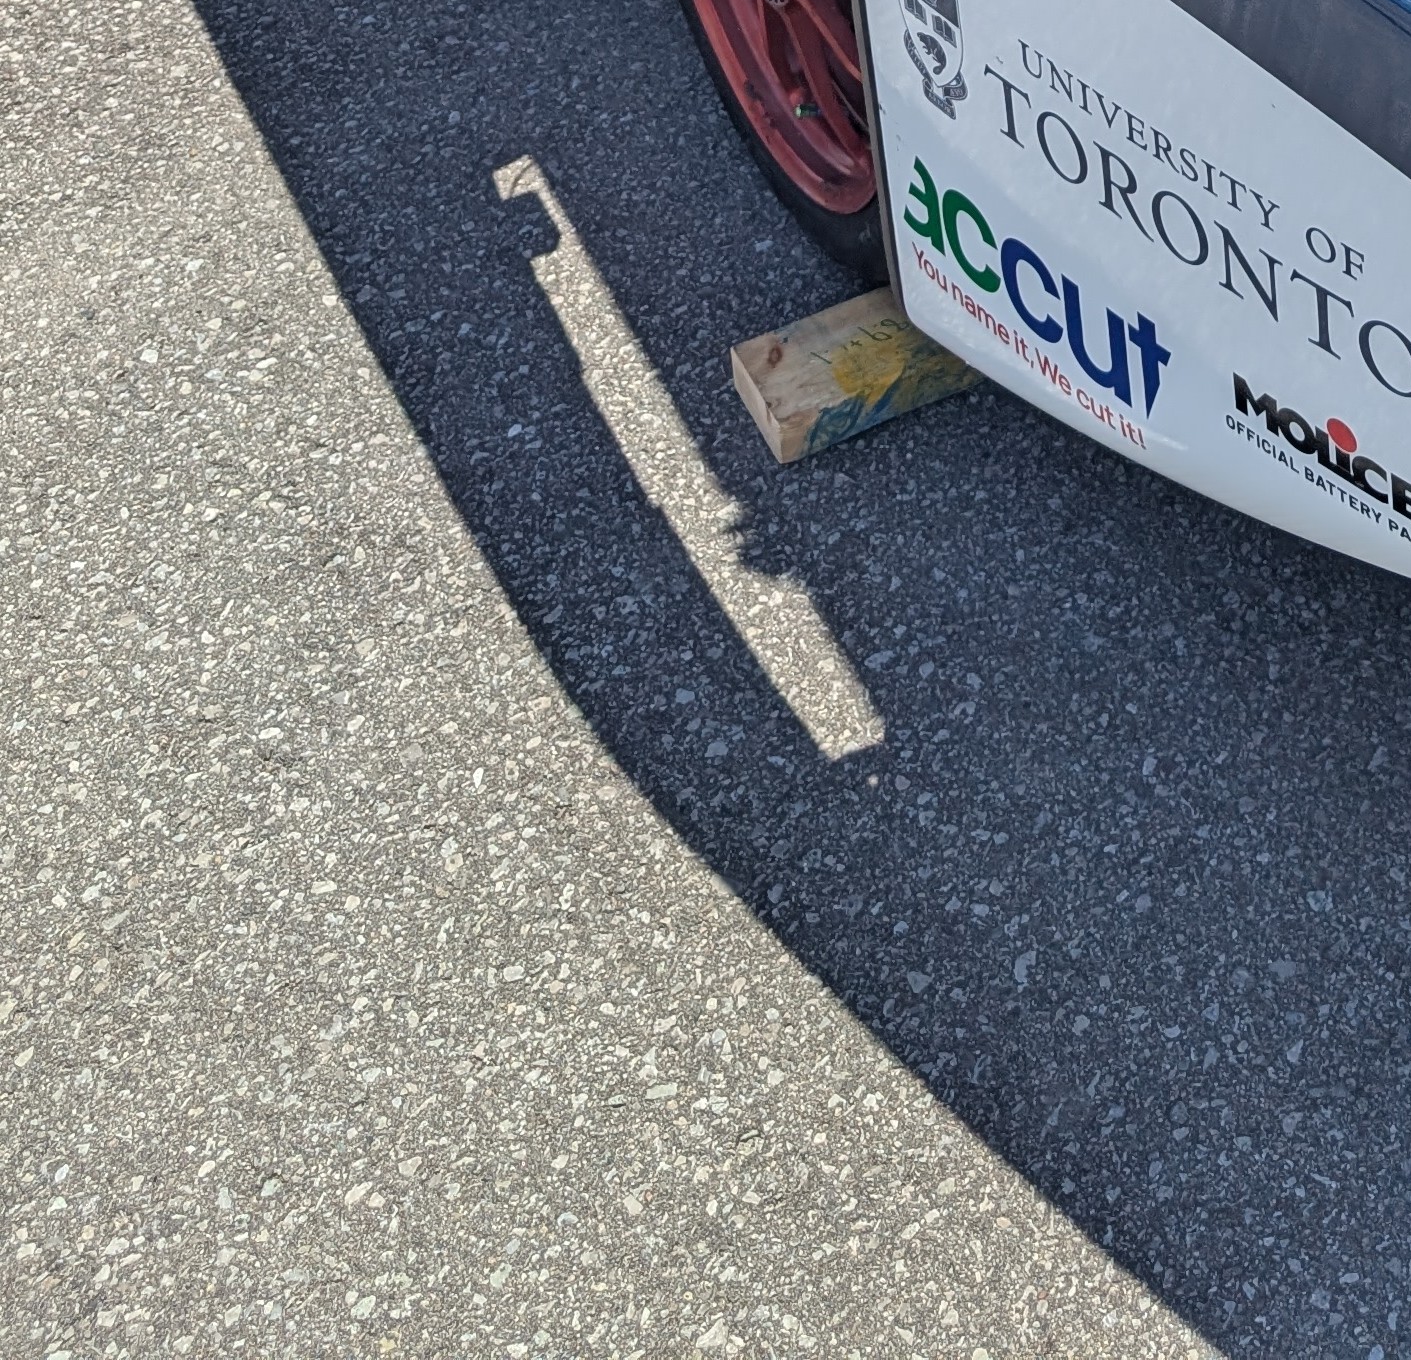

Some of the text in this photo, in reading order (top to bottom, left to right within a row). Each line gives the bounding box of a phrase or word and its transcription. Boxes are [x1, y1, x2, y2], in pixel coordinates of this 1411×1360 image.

[1017, 38, 1280, 231] UNIVERSITY
[1305, 227, 1365, 280] OF
[912, 241, 948, 293] You
[951, 282, 1010, 345] name
[1077, 388, 1116, 431] cut
[1119, 414, 1147, 450] it!
[1226, 414, 1300, 473] OFFICIAL
[1304, 466, 1382, 524] BATTERY
